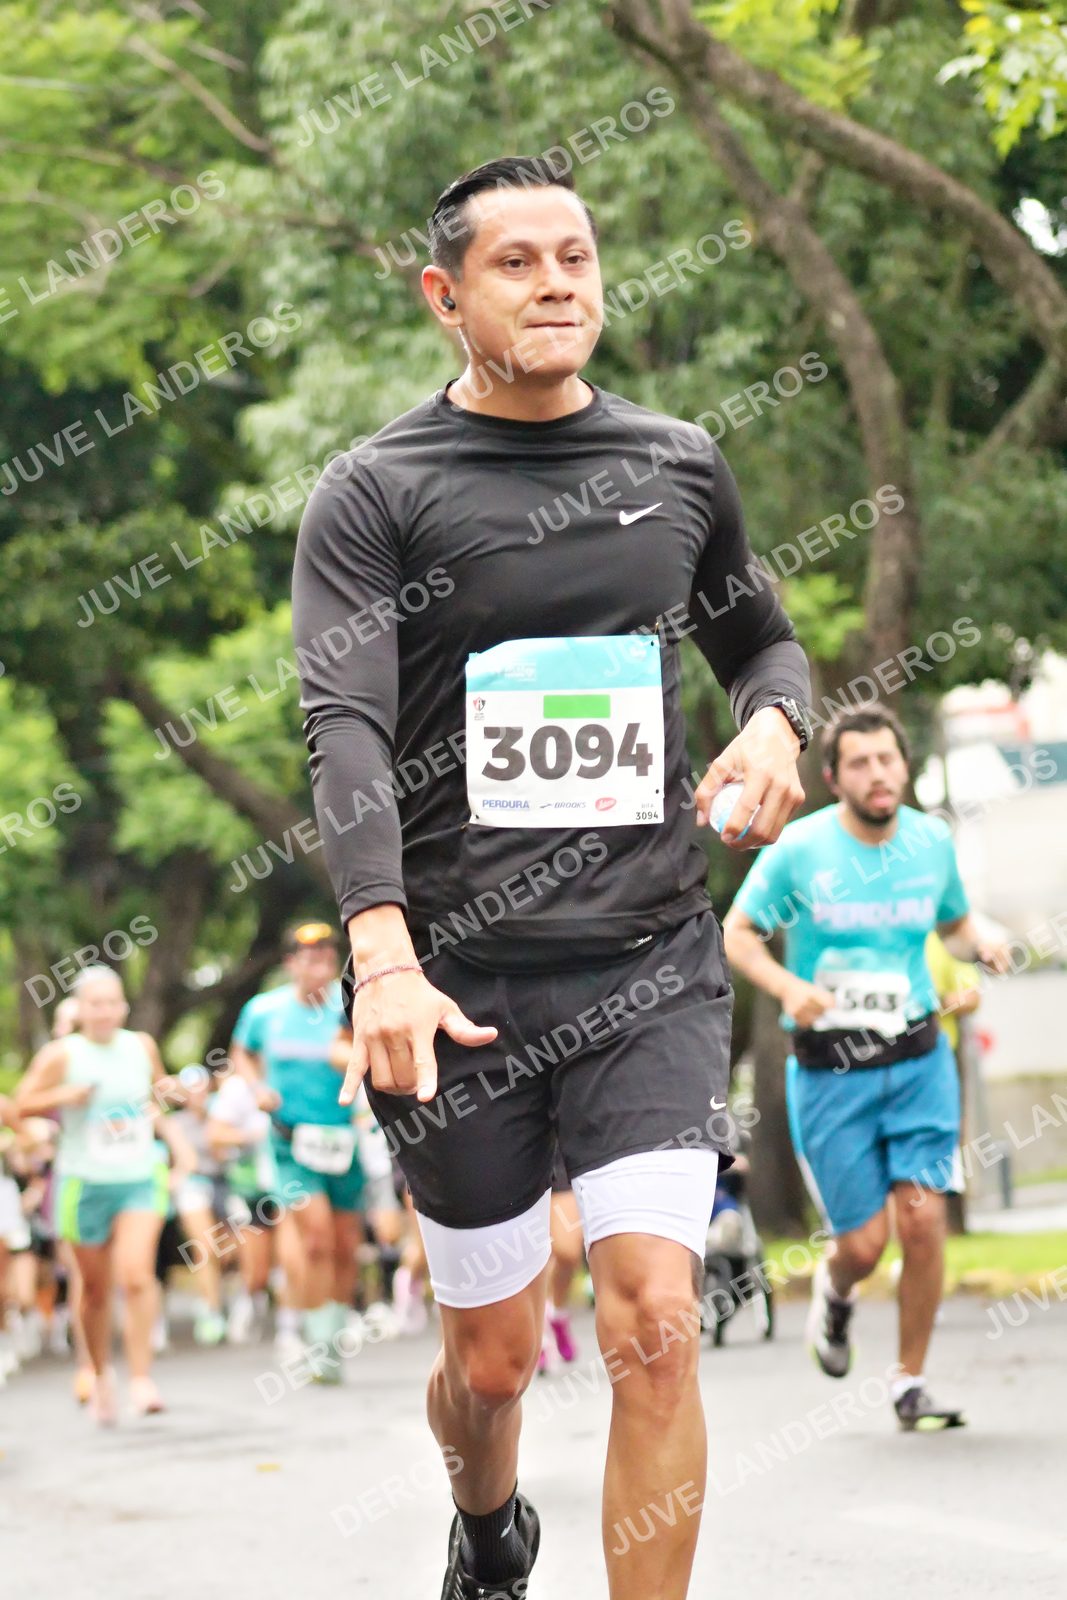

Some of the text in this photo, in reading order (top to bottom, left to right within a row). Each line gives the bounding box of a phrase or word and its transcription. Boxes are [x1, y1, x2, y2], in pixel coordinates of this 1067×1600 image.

[482, 723, 653, 781] 3094
[482, 799, 530, 809] PERDURA
[635, 811, 659, 821] 3094
[825, 985, 898, 1013] 563
